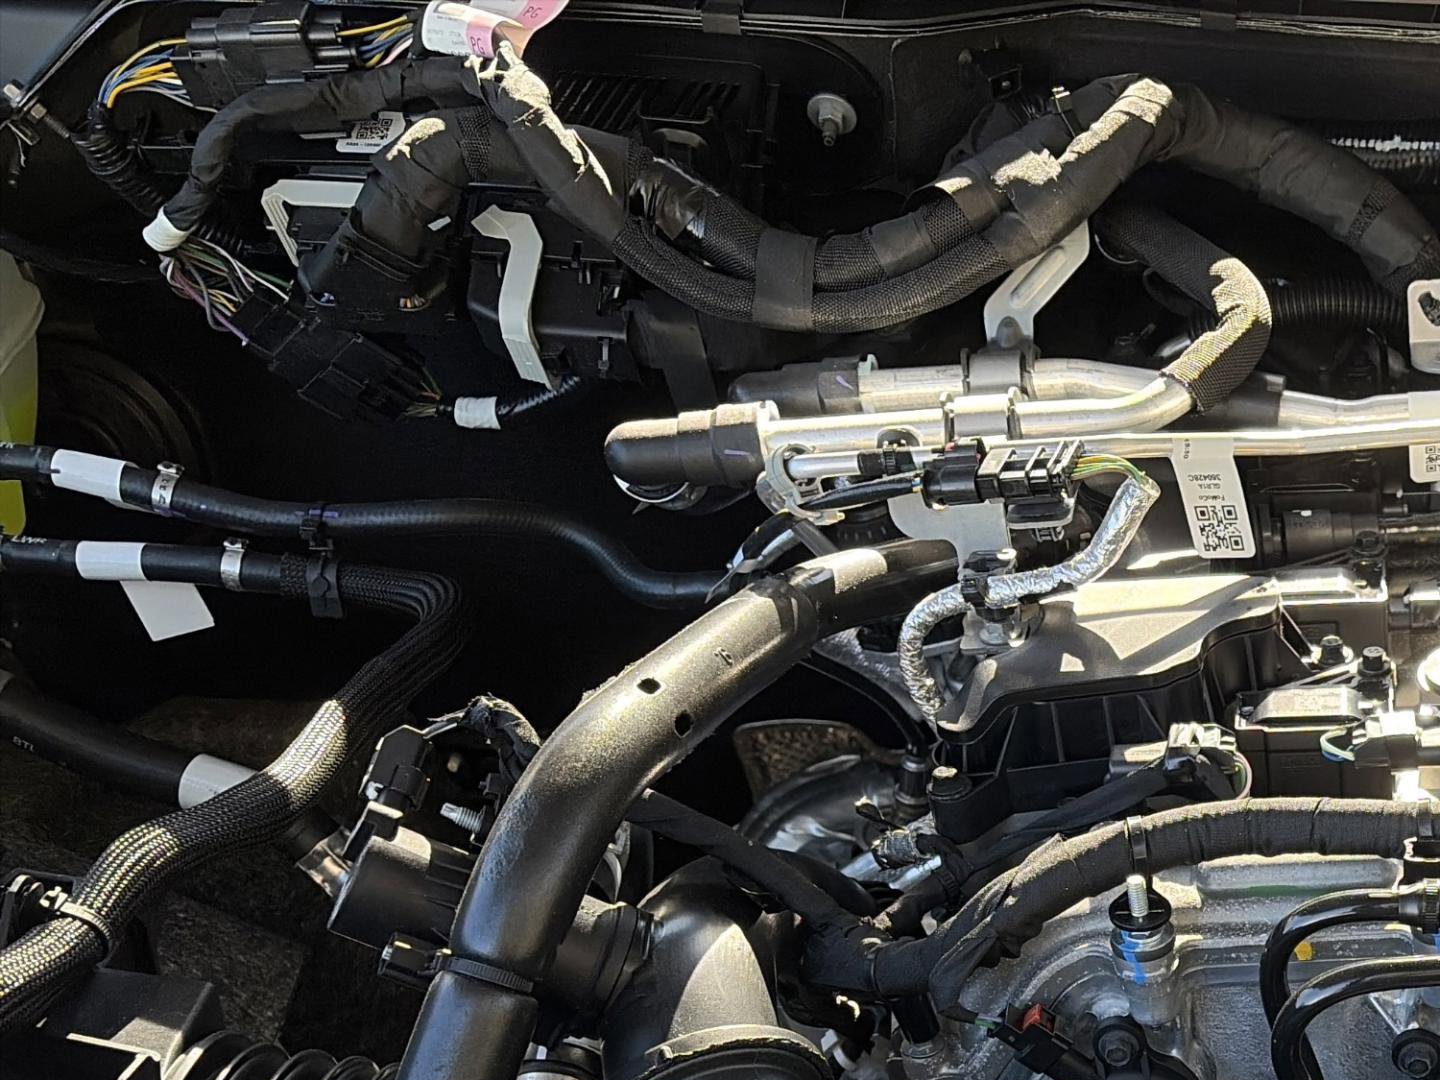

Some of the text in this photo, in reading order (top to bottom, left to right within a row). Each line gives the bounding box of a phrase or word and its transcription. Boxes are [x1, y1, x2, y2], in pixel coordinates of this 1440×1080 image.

[522, 6, 543, 19] PG
[470, 36, 486, 56] PG
[1198, 494, 1226, 502] FoMoCo
